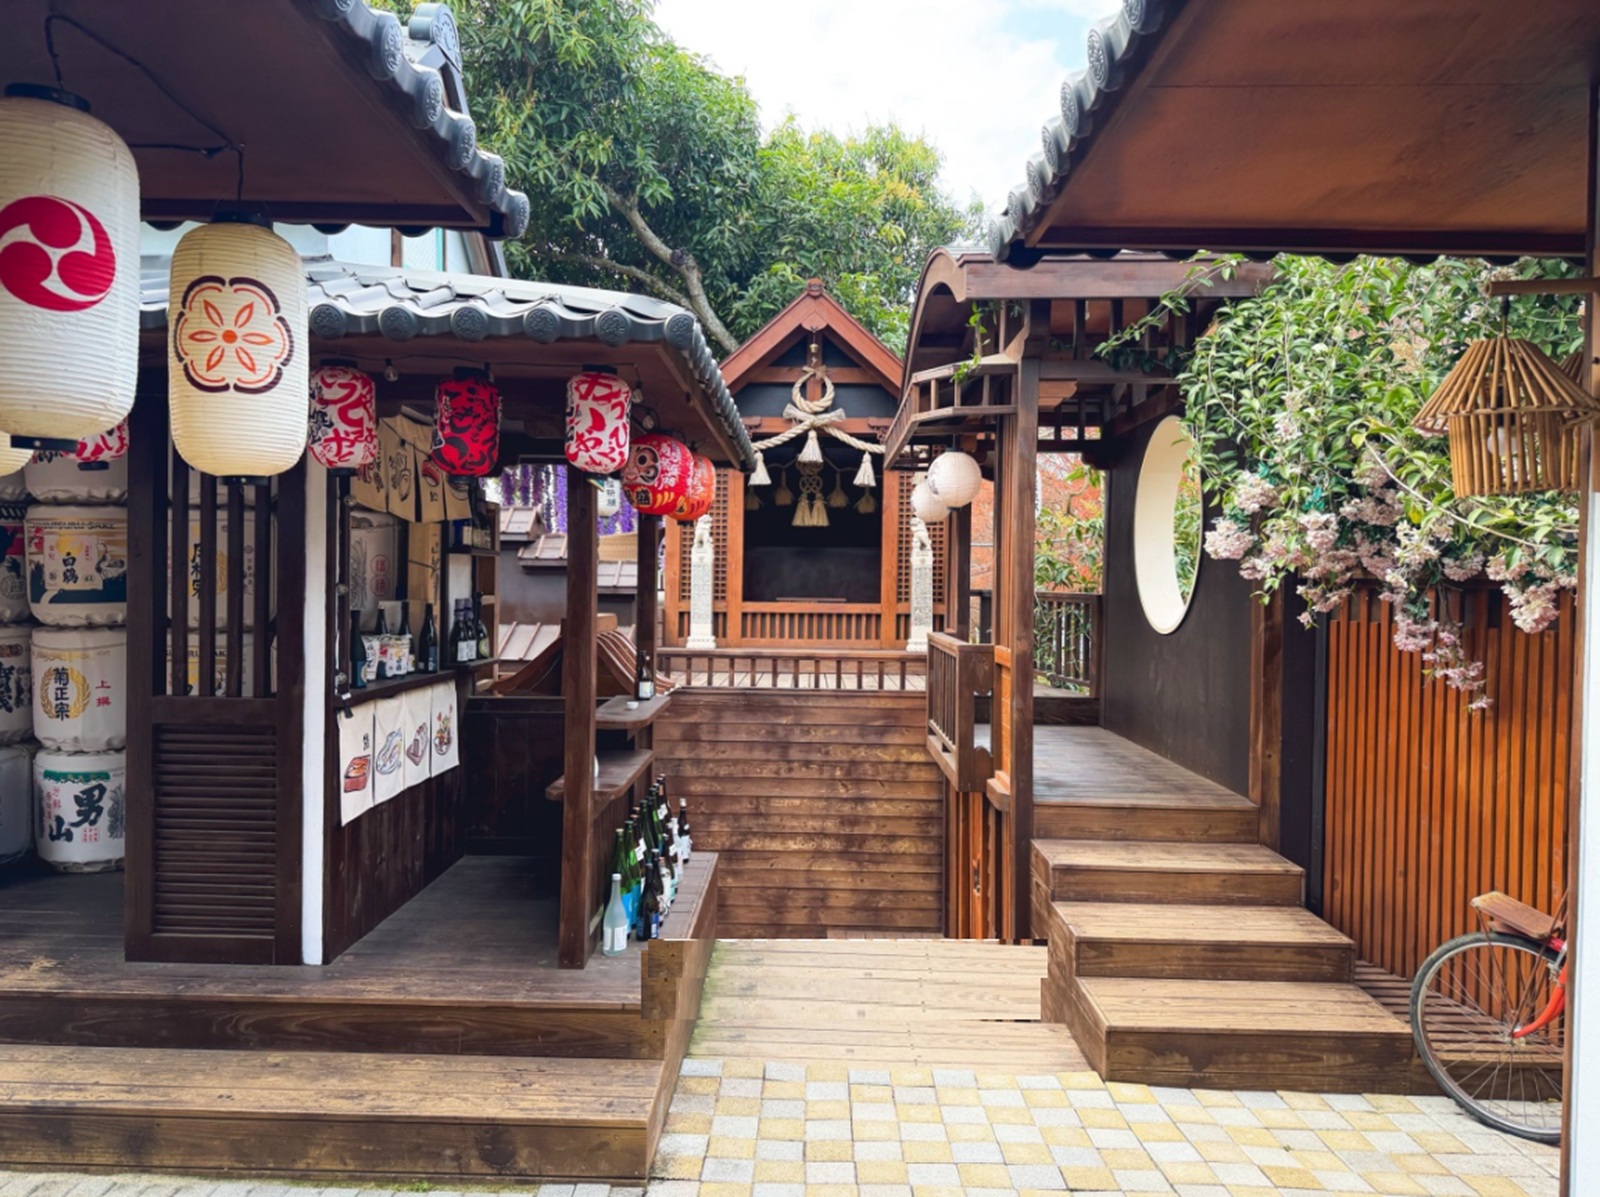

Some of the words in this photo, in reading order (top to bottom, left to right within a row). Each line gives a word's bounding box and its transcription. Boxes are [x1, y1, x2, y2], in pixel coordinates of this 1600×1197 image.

[53, 666, 71, 722] 菊正宗
[94, 679, 112, 708] 上撰
